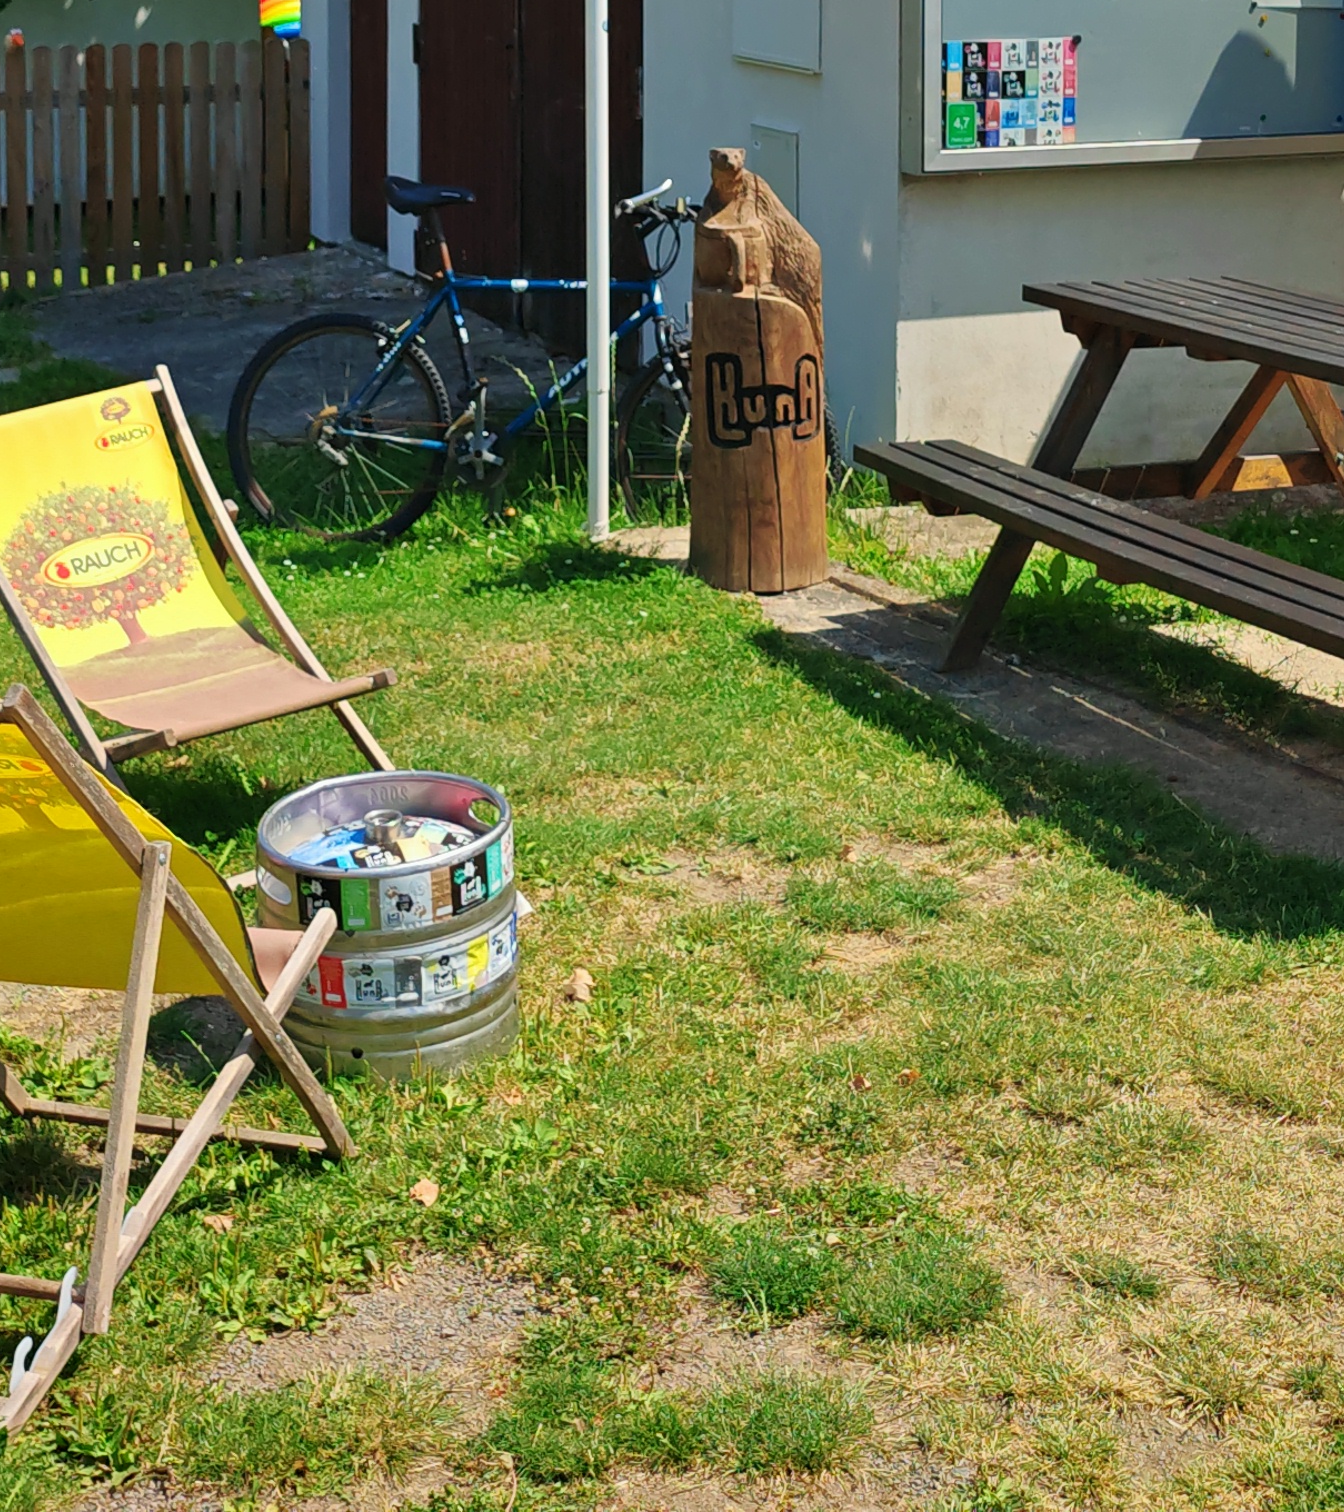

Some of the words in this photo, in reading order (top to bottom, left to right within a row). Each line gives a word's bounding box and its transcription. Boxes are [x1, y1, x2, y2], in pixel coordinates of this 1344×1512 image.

[953, 116, 970, 130] 4,7
[109, 426, 148, 446] RAUCH
[70, 541, 142, 575] RAUCH
